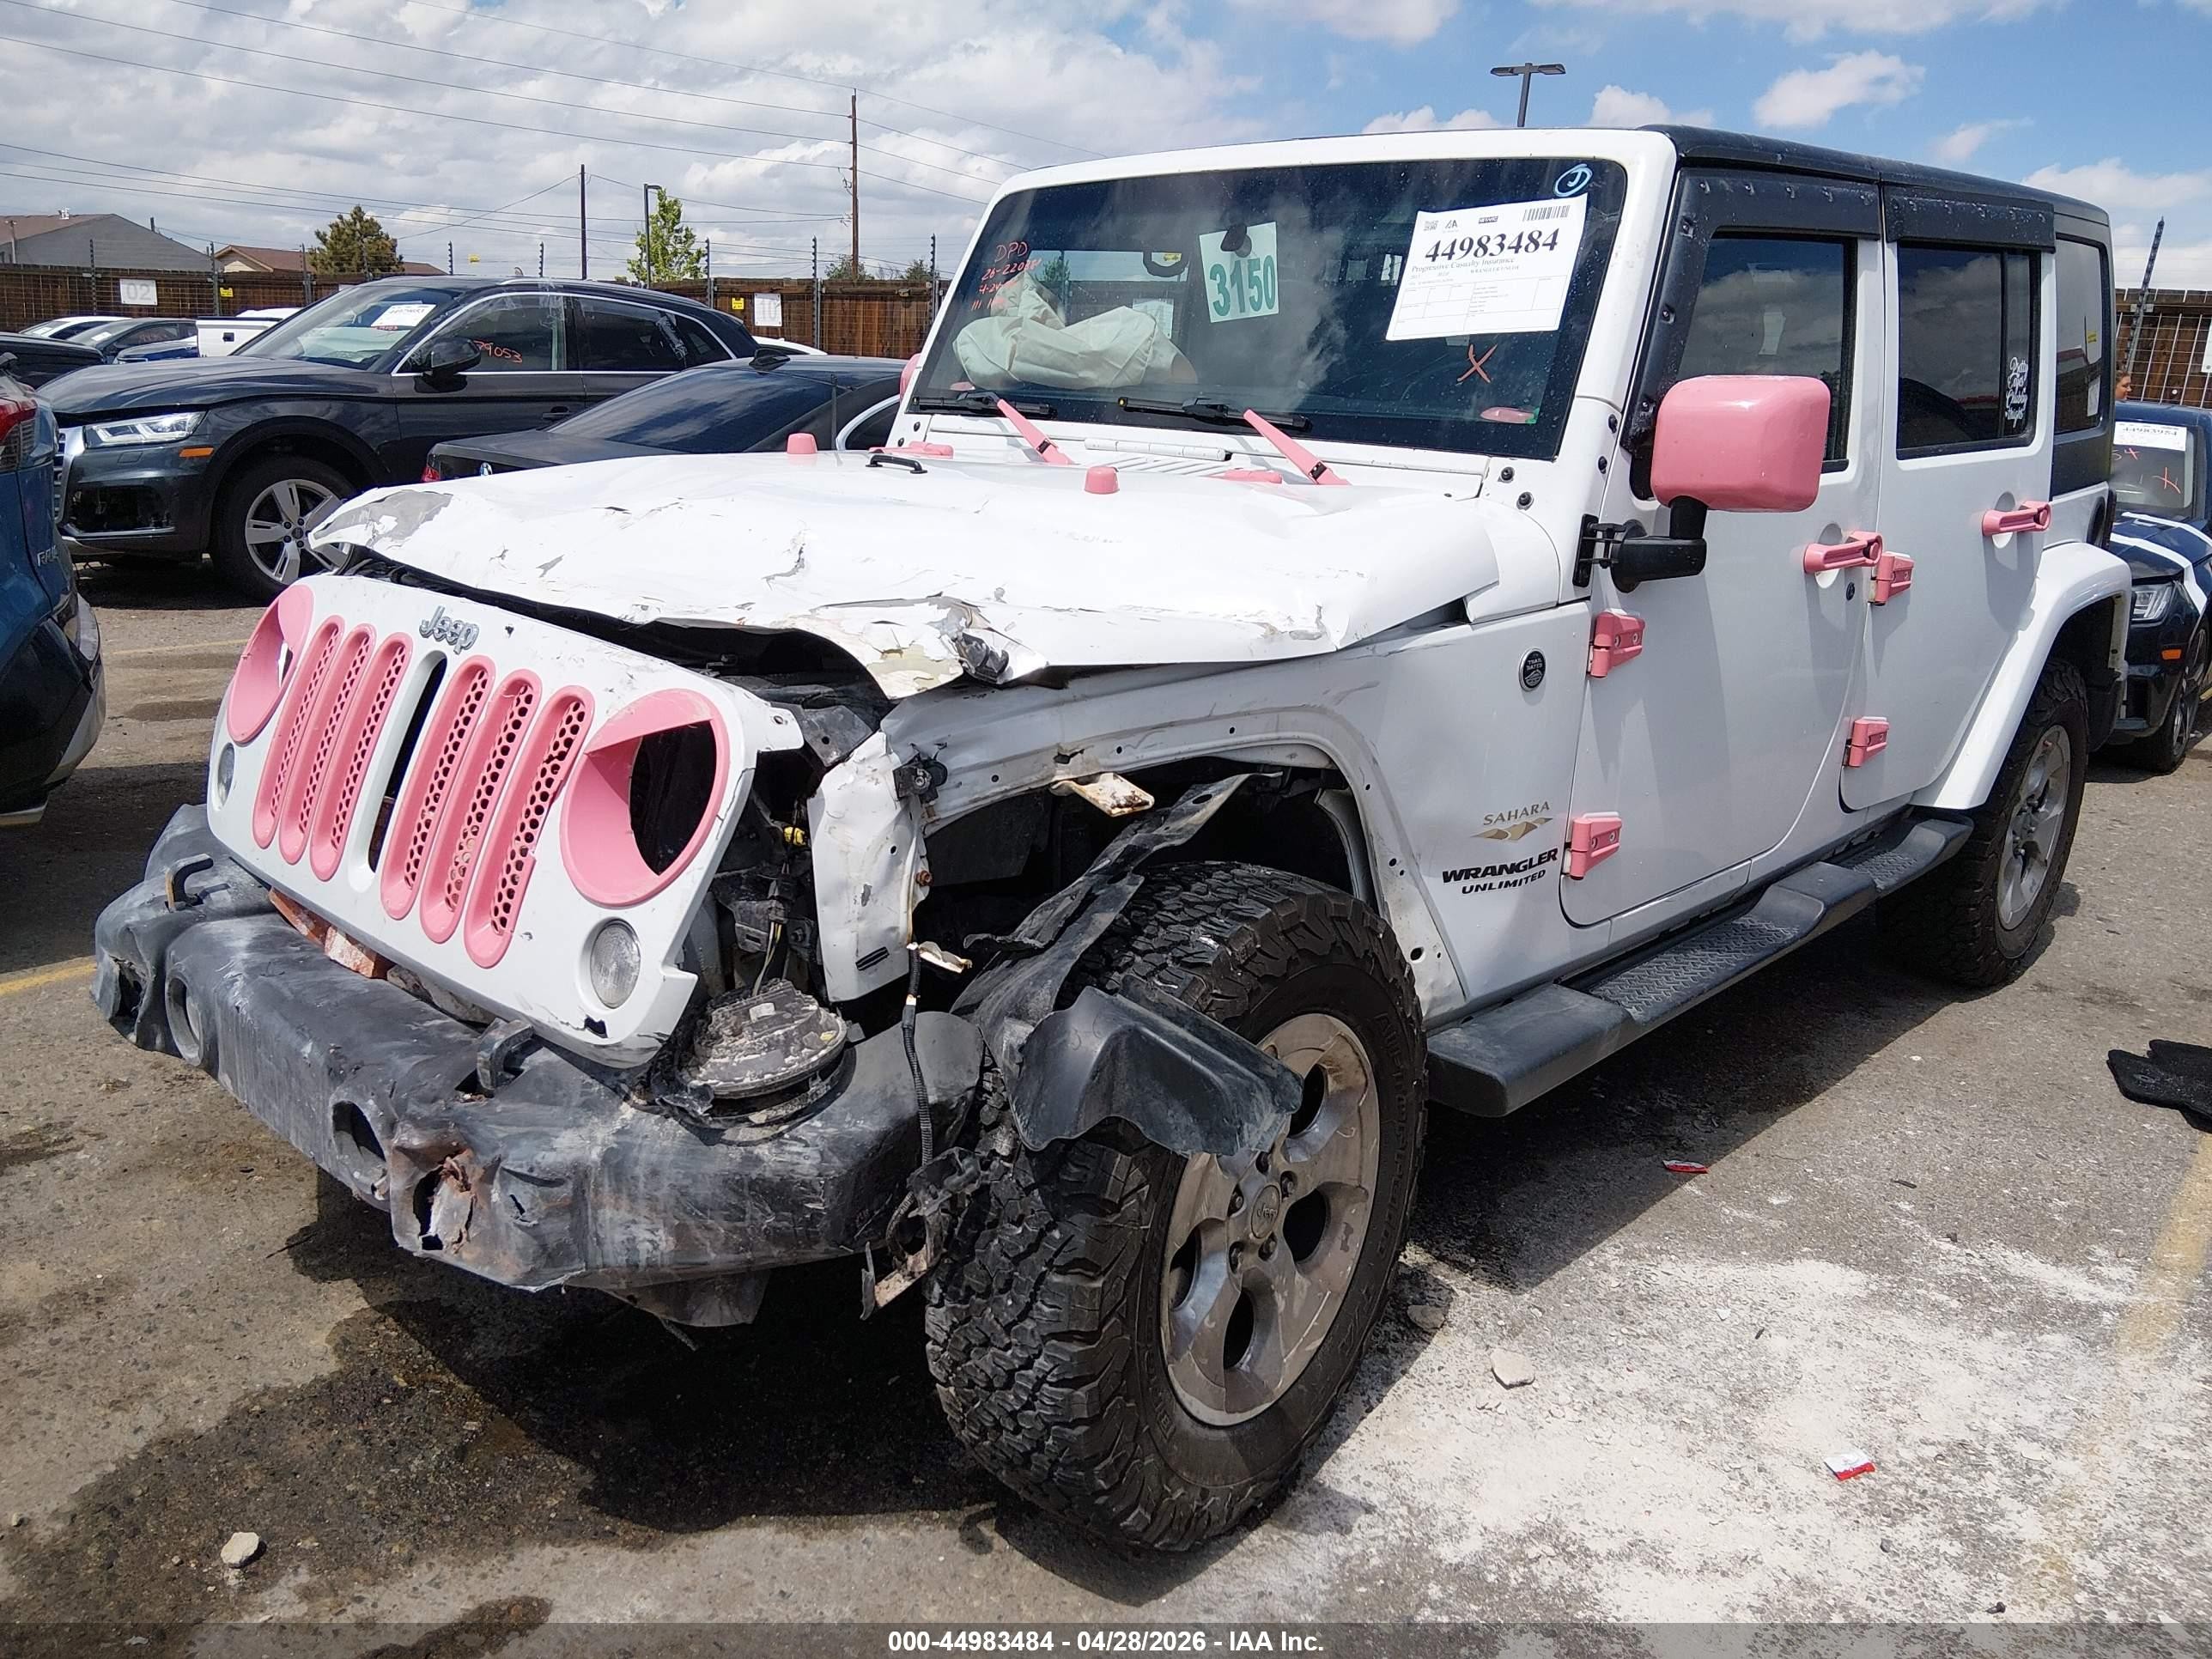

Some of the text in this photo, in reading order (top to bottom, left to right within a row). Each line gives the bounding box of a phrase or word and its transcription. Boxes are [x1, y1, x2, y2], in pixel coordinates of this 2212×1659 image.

[1425, 228, 1559, 262] 44983484
[1450, 259, 1480, 269] Casualty
[125, 283, 152, 301] 02
[1210, 255, 1276, 317] 3150
[419, 605, 480, 656] Jeep
[1483, 800, 1551, 826] SAHARA
[1442, 847, 1559, 884] WRANGLER
[1462, 869, 1547, 895] UNLIMITED
